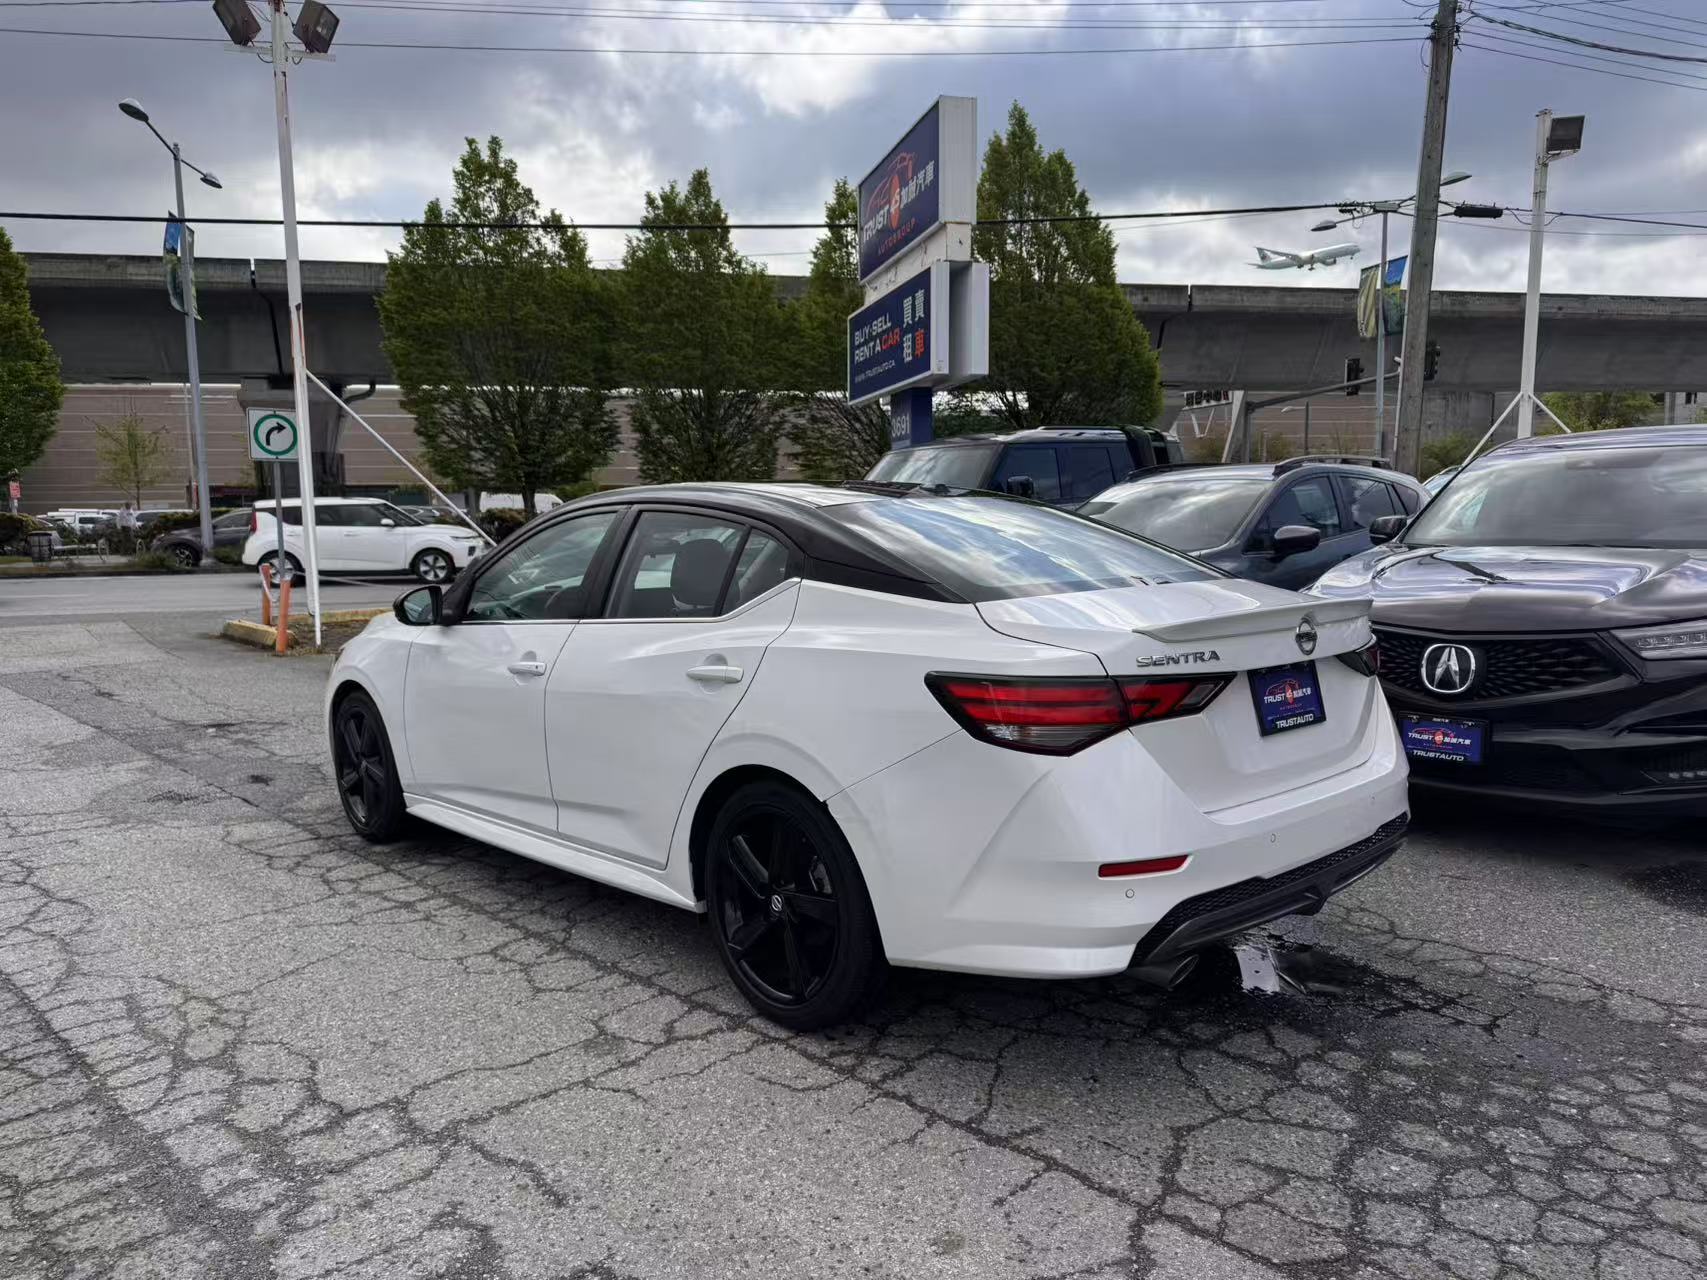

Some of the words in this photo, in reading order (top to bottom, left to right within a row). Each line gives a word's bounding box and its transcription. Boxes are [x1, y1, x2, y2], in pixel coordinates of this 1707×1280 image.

[863, 204, 889, 244] TRUST
[854, 341, 875, 365] RENT
[875, 338, 882, 354] A
[881, 328, 900, 351] CAR
[891, 413, 910, 438] 3691
[1136, 650, 1220, 668] SENTRA
[1263, 693, 1285, 704] TRUST
[1408, 732, 1433, 741] TRUST
[1412, 749, 1465, 762] TRUSTAUTO
